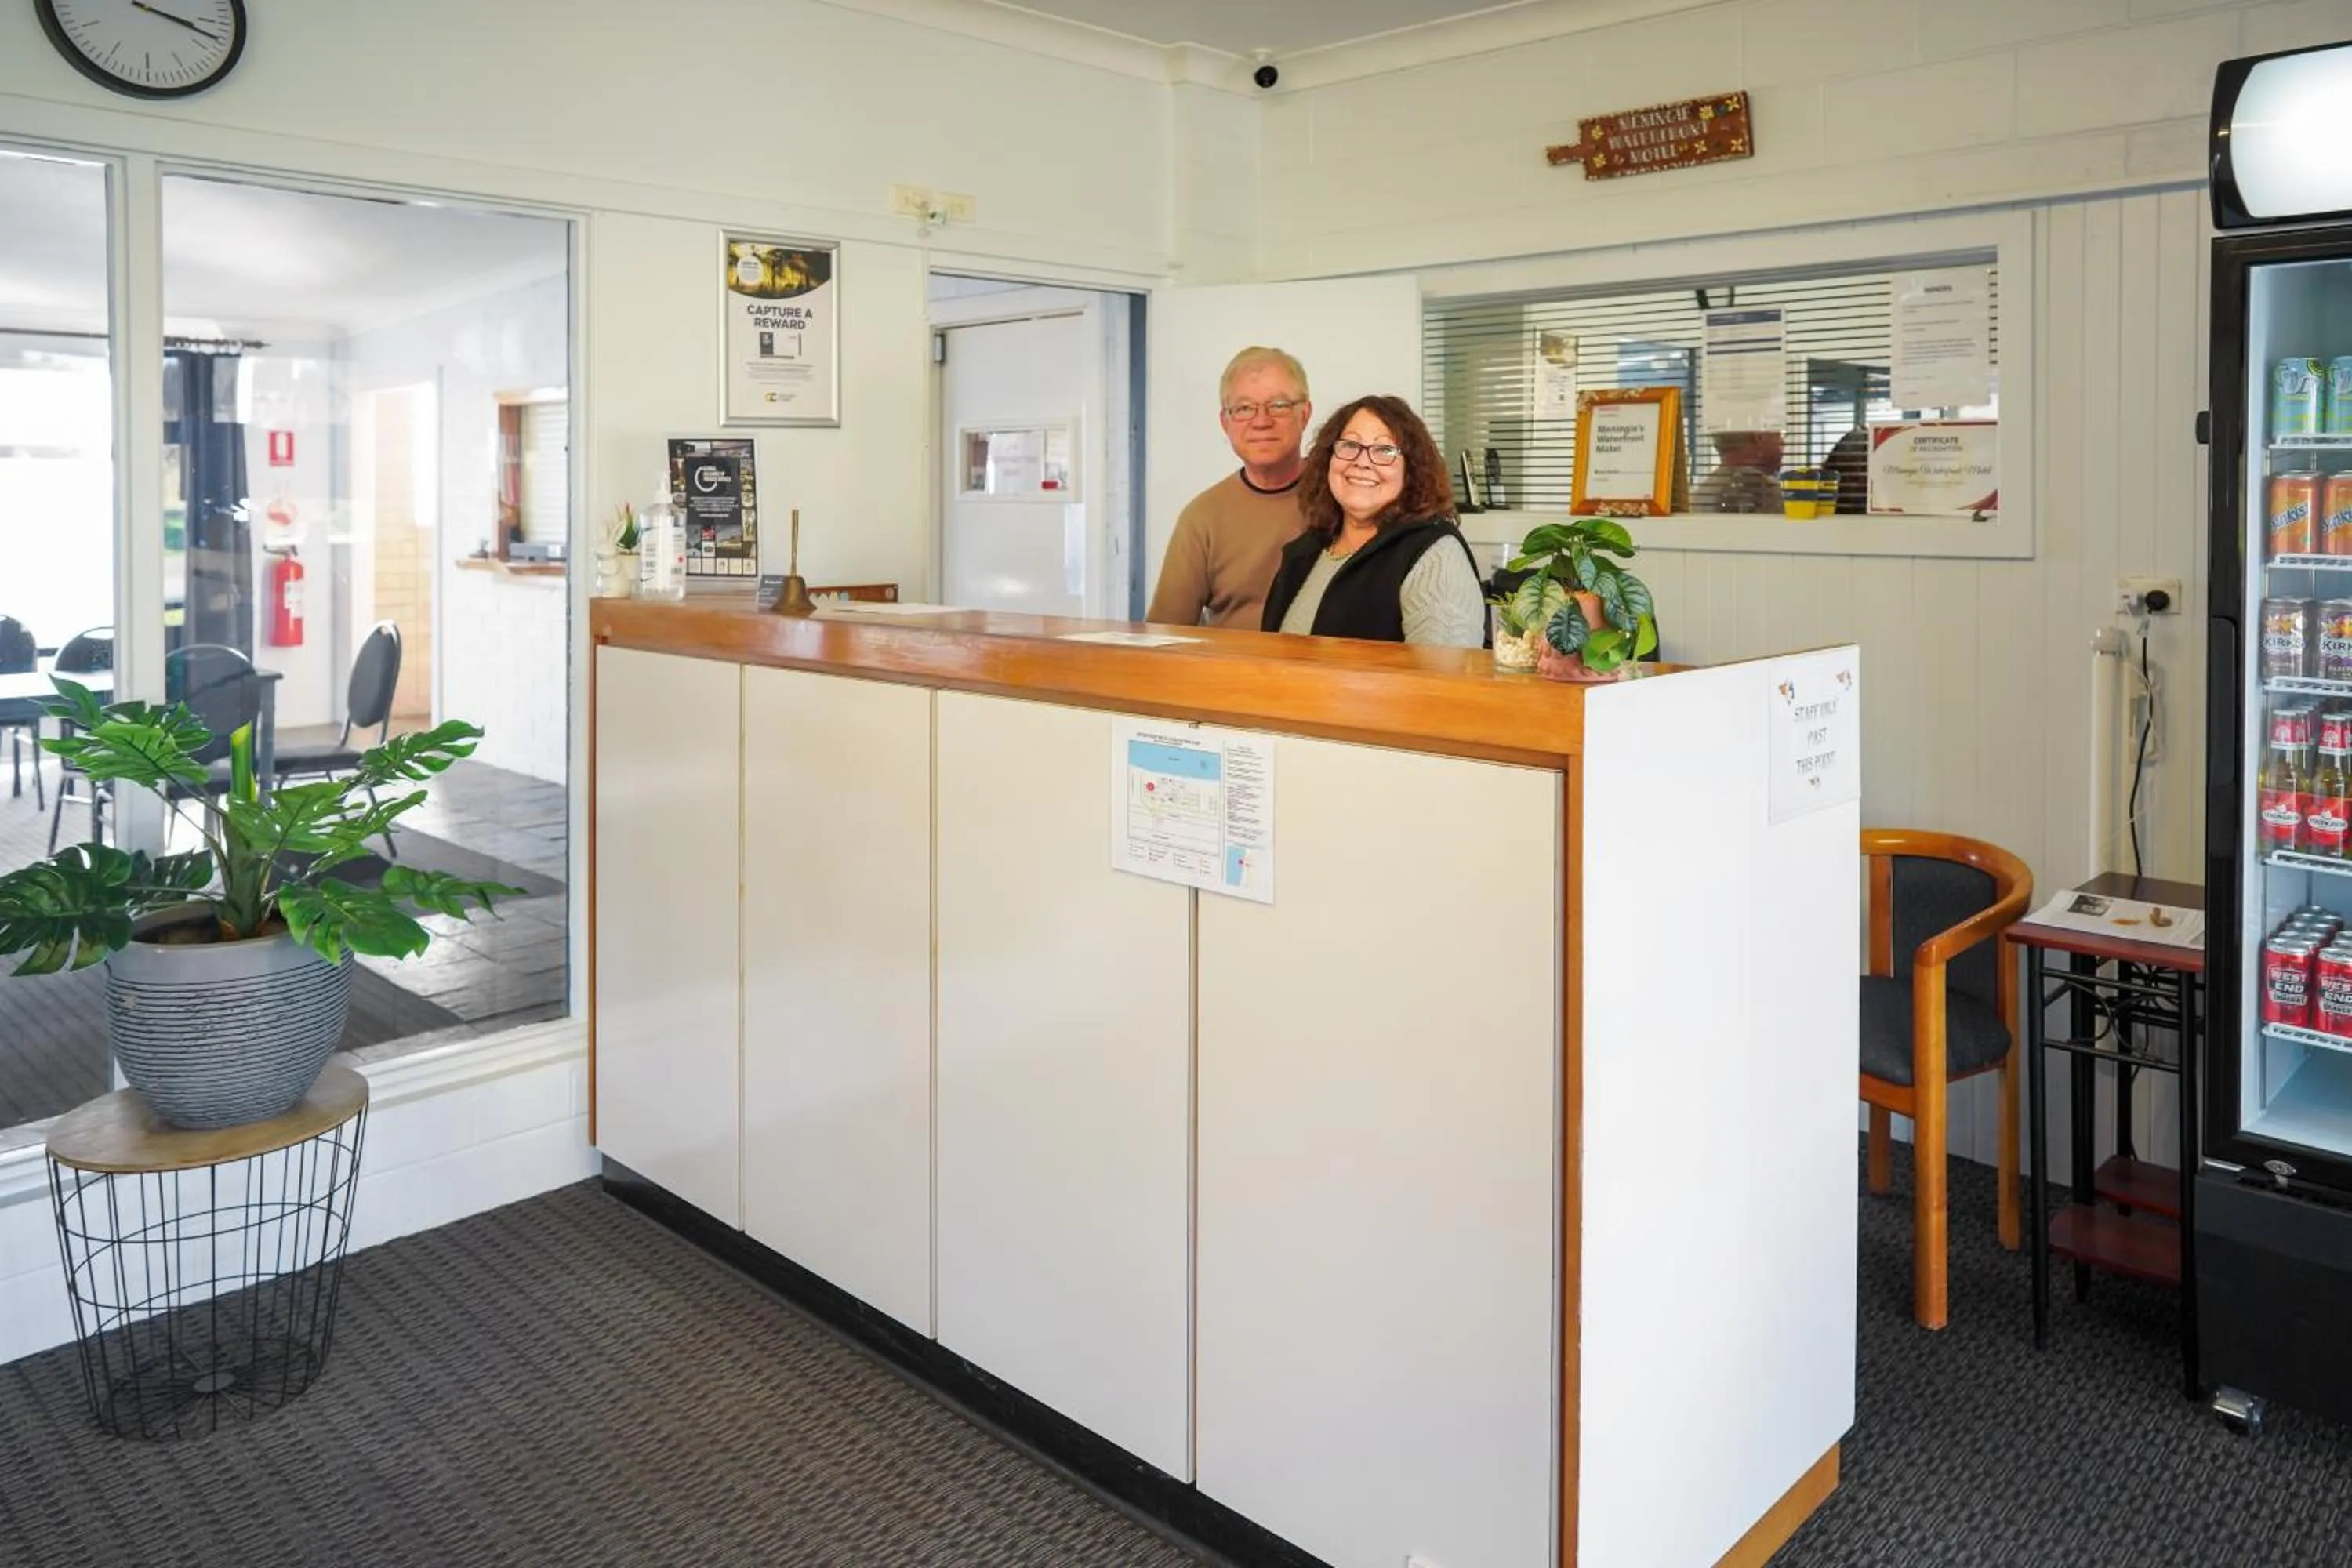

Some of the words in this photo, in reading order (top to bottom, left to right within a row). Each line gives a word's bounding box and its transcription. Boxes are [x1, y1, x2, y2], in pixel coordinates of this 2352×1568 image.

[747, 304, 802, 318] CAPTURE
[804, 308, 813, 319] A
[754, 317, 805, 330] REWARD
[1597, 425, 1646, 436] Meningie's
[1596, 434, 1645, 445] Waterfront
[1913, 436, 1959, 445] CERTIFICATE
[2322, 638, 2352, 651] KIR
[2274, 982, 2305, 994] END
[2321, 978, 2352, 992] WES
